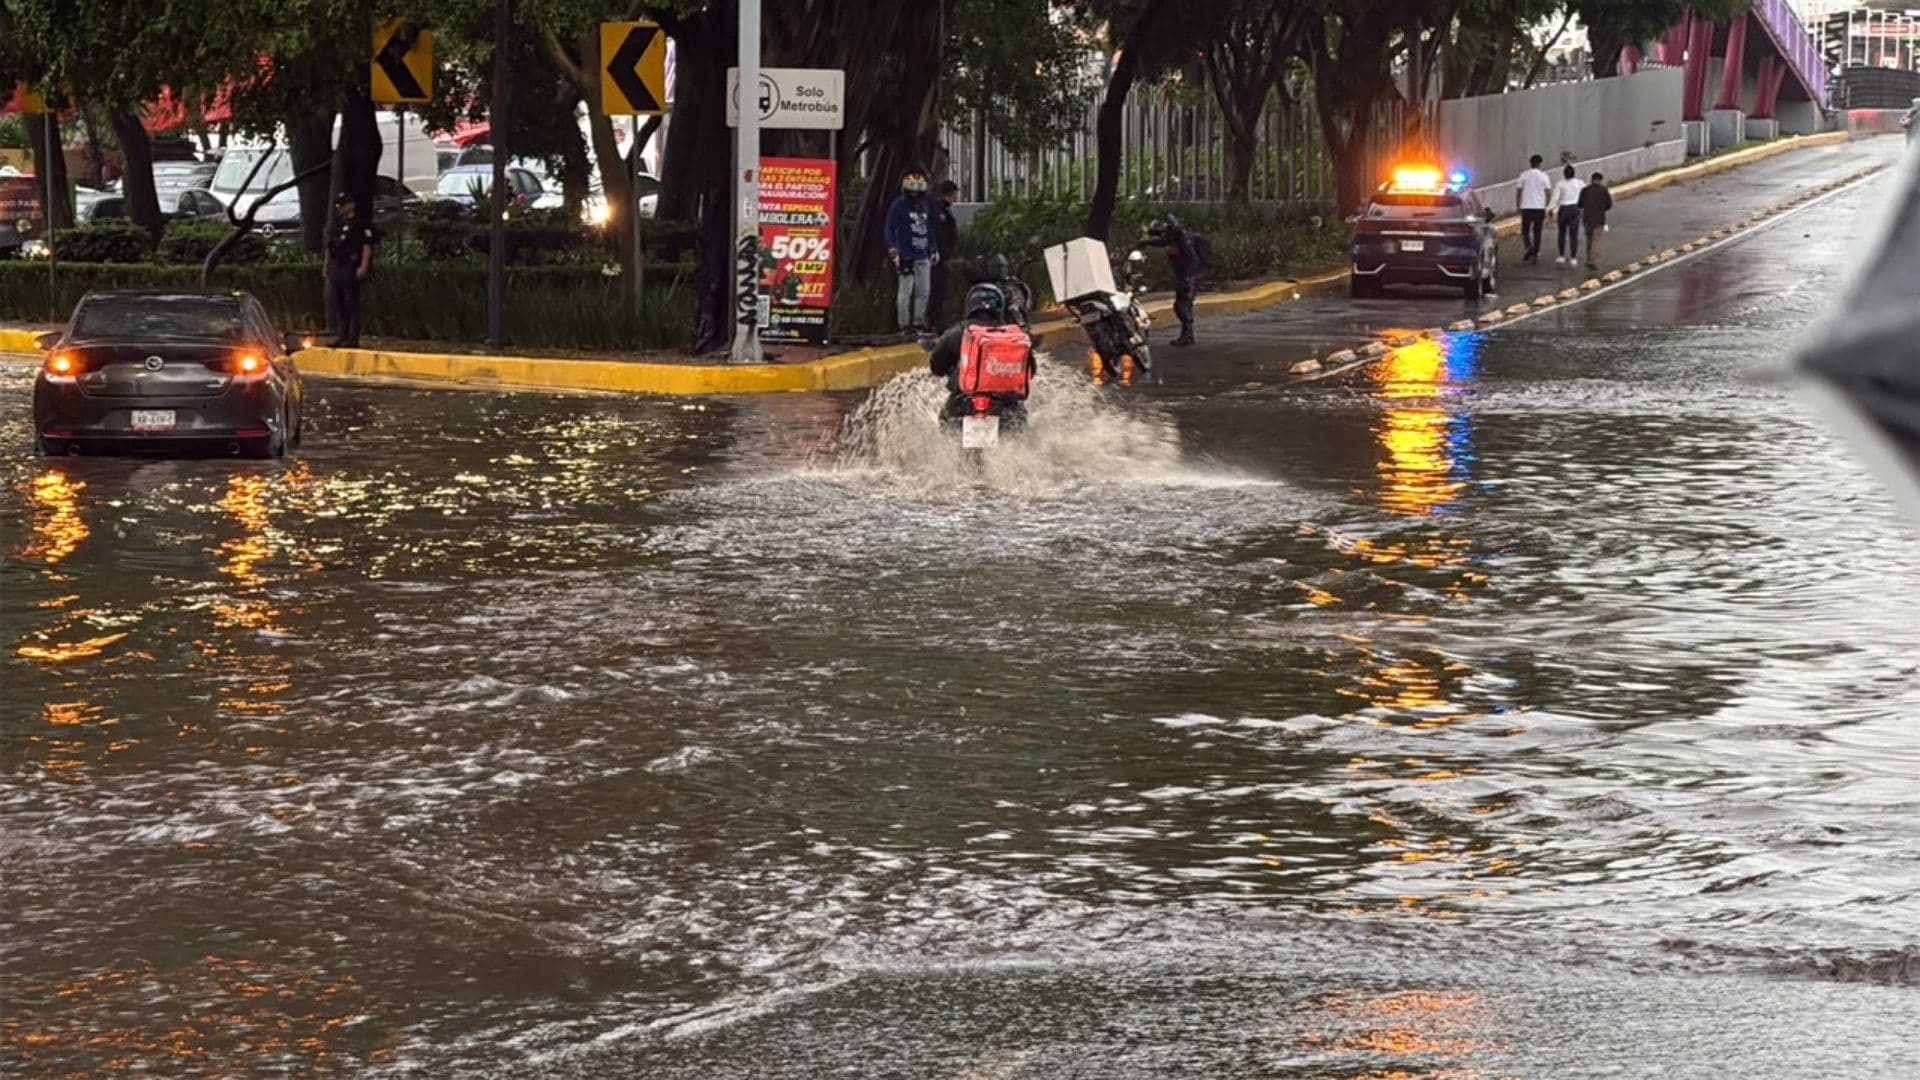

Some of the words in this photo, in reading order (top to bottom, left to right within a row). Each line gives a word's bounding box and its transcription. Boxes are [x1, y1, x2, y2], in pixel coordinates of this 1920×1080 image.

[796, 85, 824, 97] Solo
[780, 99, 838, 113] Metrobús
[758, 203, 781, 211] ENTA
[771, 235, 831, 260] 50%
